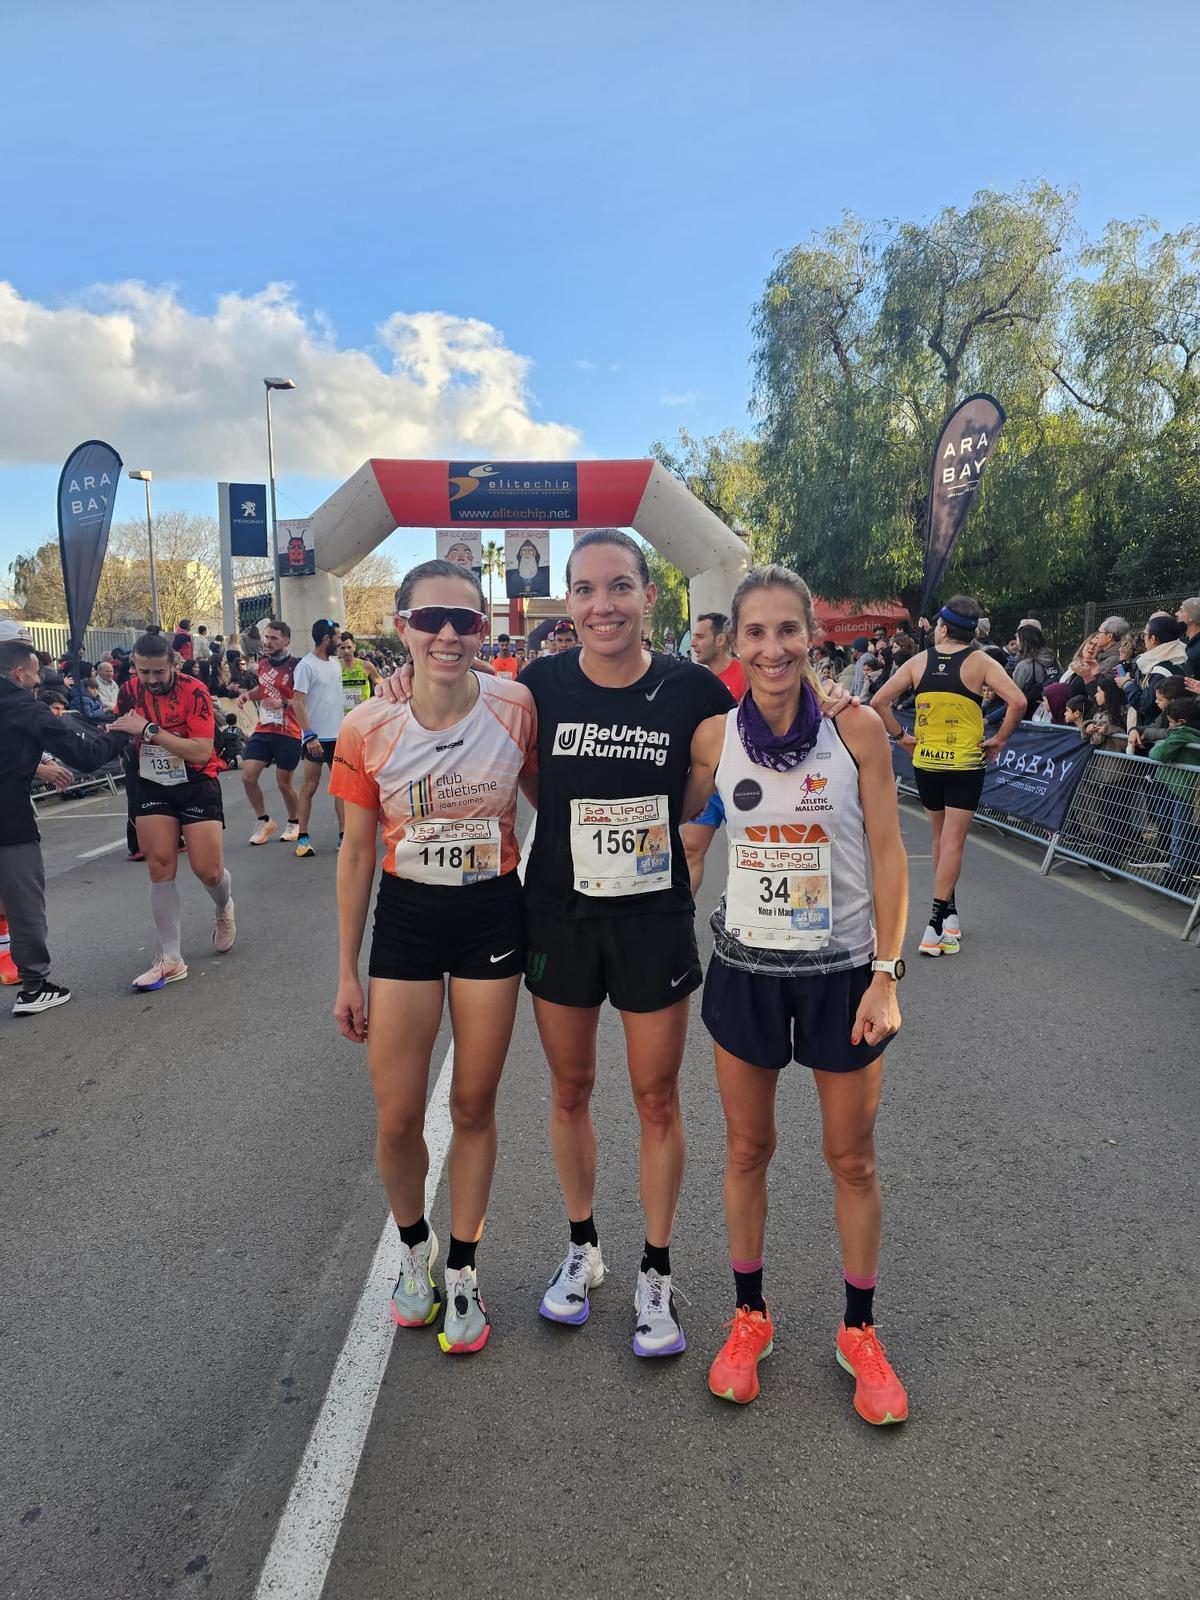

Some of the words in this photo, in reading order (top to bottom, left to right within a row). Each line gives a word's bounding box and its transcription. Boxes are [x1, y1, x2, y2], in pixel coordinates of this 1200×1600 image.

[943, 432, 988, 459] ARA
[943, 456, 987, 484] BAY
[69, 472, 111, 493] ARA
[488, 479, 570, 490] elitechip
[459, 508, 570, 519] www.elitechip.net
[583, 723, 671, 746] BeUrban
[580, 740, 667, 767] Running
[150, 759, 171, 770] 133
[436, 772, 462, 787] club
[437, 780, 497, 800] atletisme
[439, 801, 457, 810] joan
[458, 797, 484, 807] comes
[795, 804, 834, 812] MALLORCA
[800, 797, 829, 805] ATLETIC
[610, 804, 654, 816] Llego
[592, 828, 650, 855] 1567
[418, 845, 475, 869] 1181
[764, 849, 814, 862] Llego
[759, 876, 791, 904] 34
